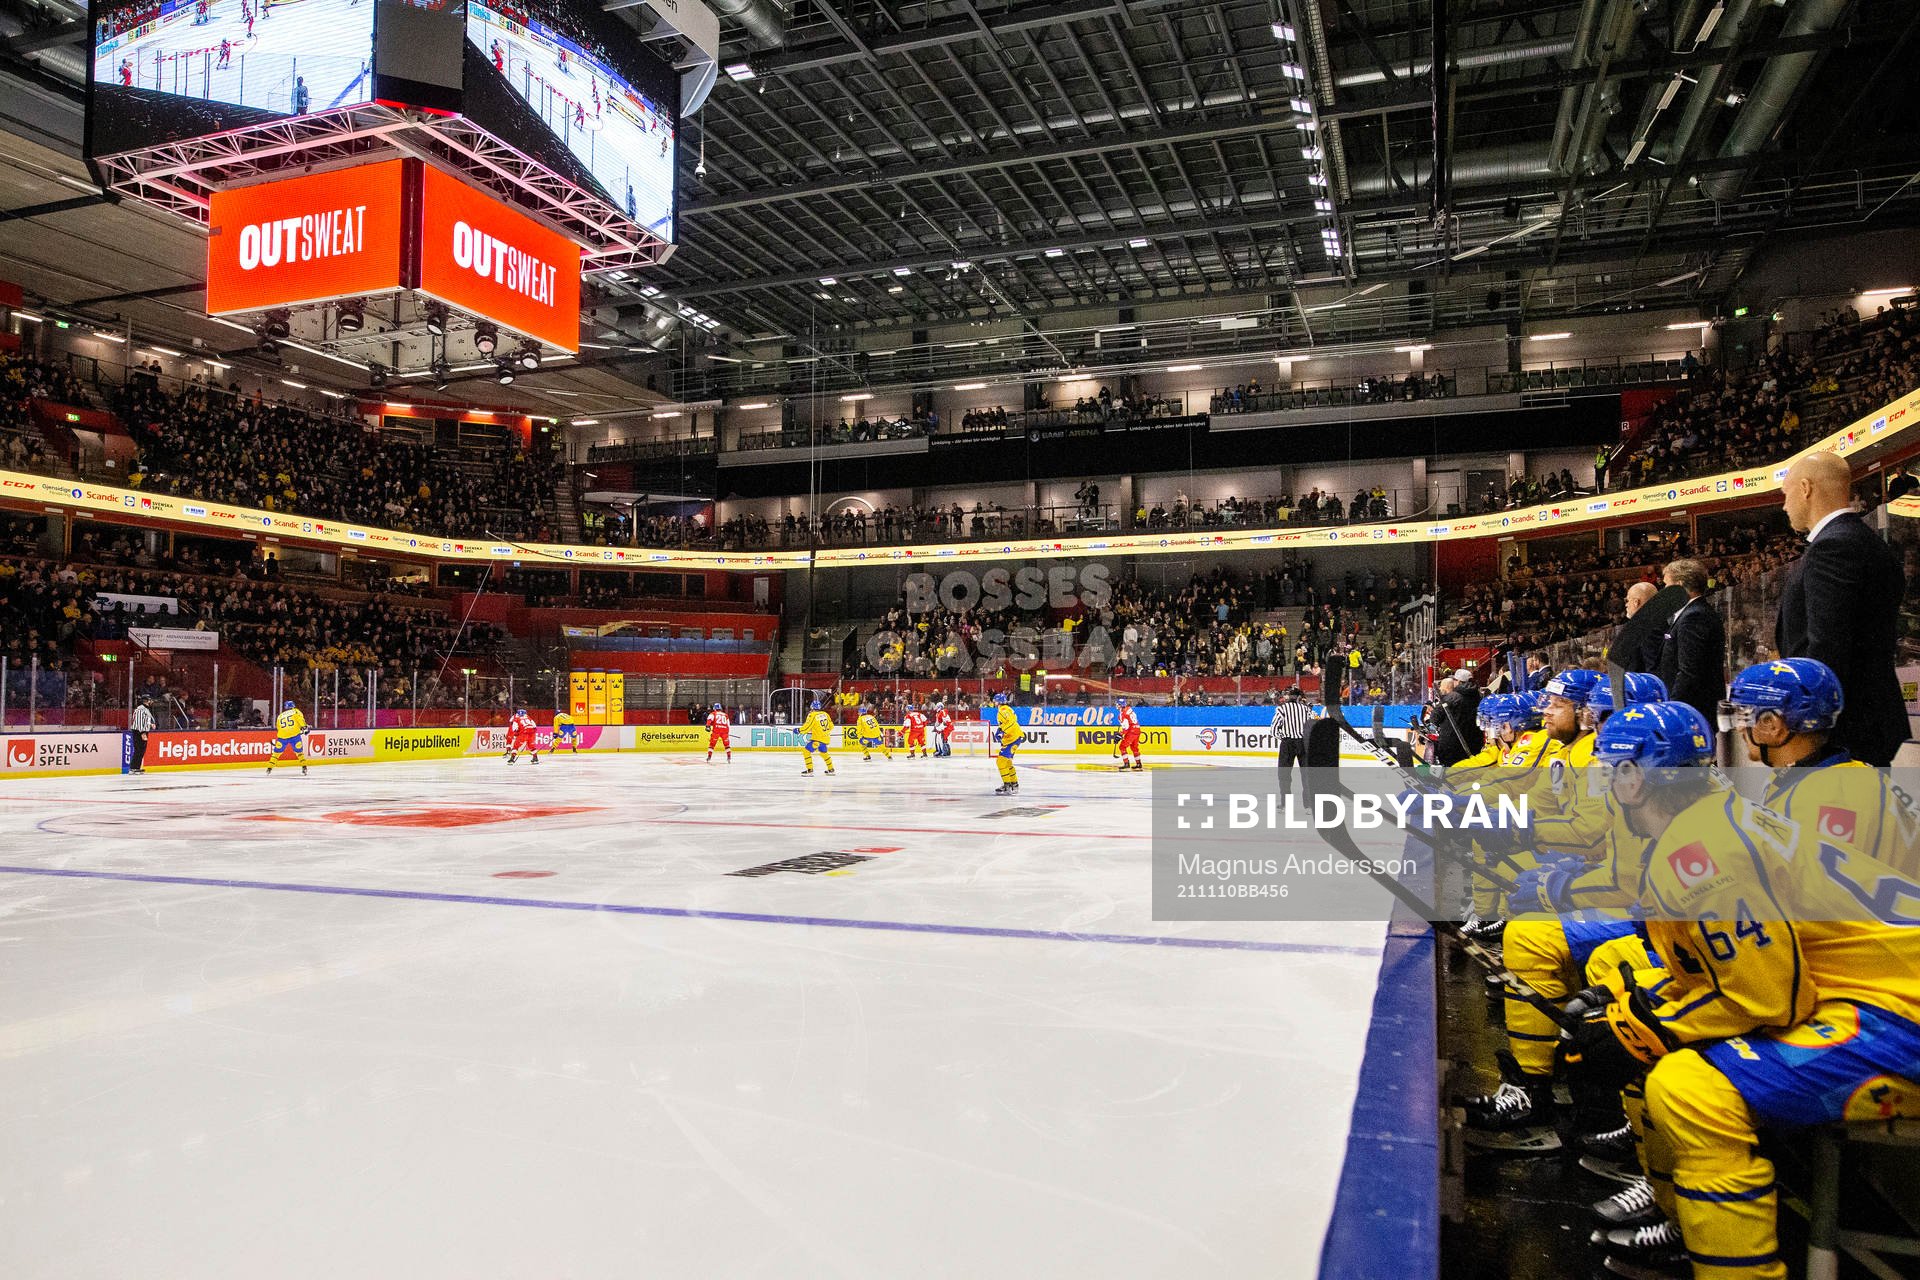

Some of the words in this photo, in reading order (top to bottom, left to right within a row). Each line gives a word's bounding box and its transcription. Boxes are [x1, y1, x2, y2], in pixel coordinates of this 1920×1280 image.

[1744, 475, 1767, 484] SVENSKA
[2, 480, 36, 490] CCM
[1679, 484, 1711, 497] Scandic
[86, 490, 120, 503] Scandic
[1613, 497, 1638, 507] CCM
[211, 511, 236, 519] CCM
[1511, 513, 1536, 524] Scandic
[273, 519, 300, 529] Scandic
[1340, 530, 1369, 539] Scandic
[418, 540, 439, 550] Scandic
[575, 550, 600, 558] Scandic
[279, 714, 295, 729] 55
[715, 713, 728, 725] 20
[328, 737, 366, 747] SVENSKA
[385, 736, 410, 752] Heja
[411, 735, 461, 752] publiken!
[40, 743, 99, 755] SVENSKA
[159, 739, 197, 760] Heja
[327, 747, 349, 756] SPEL
[39, 755, 71, 767] SPEL
[1697, 898, 1772, 962] 64
